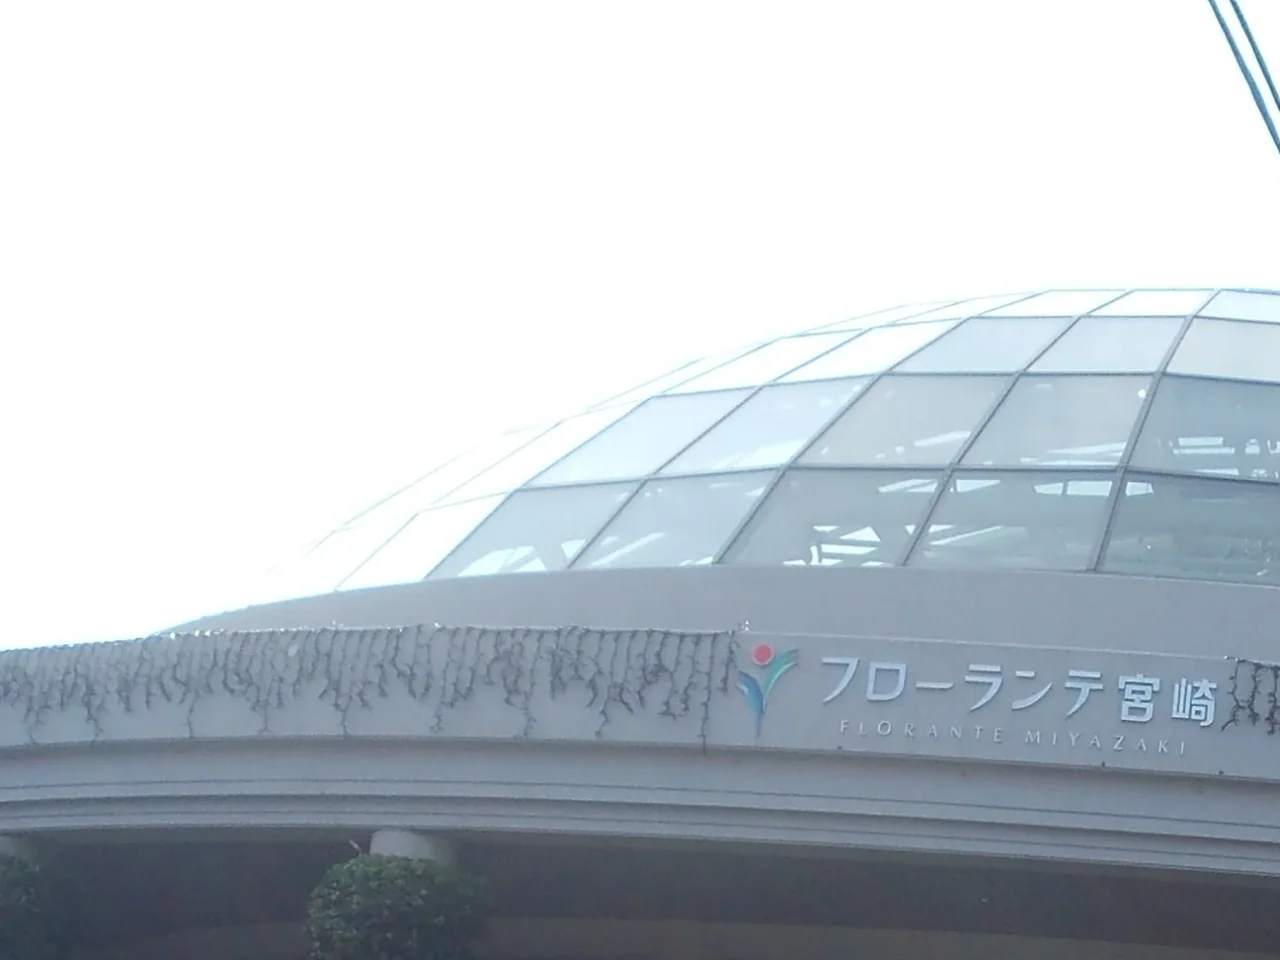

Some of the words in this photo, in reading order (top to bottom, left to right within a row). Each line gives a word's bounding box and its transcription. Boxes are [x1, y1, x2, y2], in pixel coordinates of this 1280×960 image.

[820, 655, 1218, 728] フローランテ宮崎
[839, 719, 1005, 744] FLORANTE
[1025, 731, 1187, 756] MIYAZAKI
